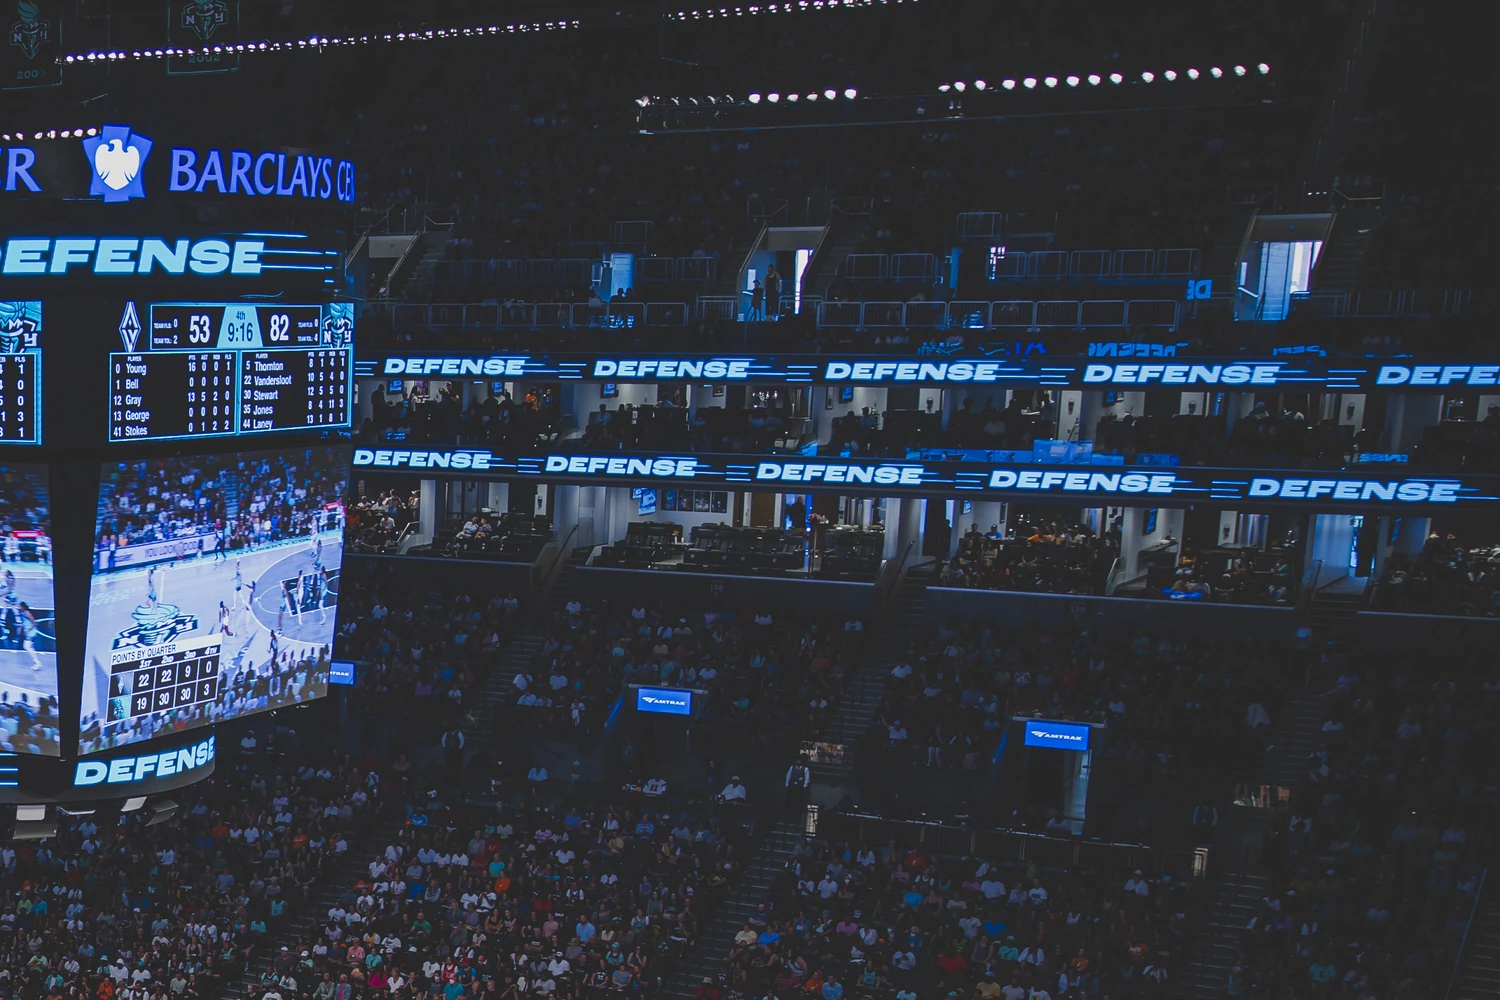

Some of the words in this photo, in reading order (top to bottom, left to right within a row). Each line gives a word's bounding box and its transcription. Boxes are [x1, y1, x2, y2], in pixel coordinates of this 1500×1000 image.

[169, 146, 332, 199] BARCLAYS
[189, 315, 210, 343] 53
[236, 311, 245, 320] 4th
[270, 314, 289, 341] 82
[228, 322, 253, 342] 9:16
[126, 363, 146, 375] Young
[254, 361, 283, 371] Thornton
[384, 358, 525, 375] DEFENSE
[593, 361, 748, 378] DEFENSE
[825, 362, 998, 381] DEFENSE
[1084, 365, 1279, 384] DEFENSE
[125, 379, 138, 389] Bell
[254, 375, 291, 386] Vandersloot
[125, 395, 141, 407] Gray
[254, 390, 278, 400] Stewart
[125, 410, 149, 422] George
[253, 405, 273, 415] Jones
[125, 426, 147, 436] Stokes
[253, 420, 273, 430] Laney
[353, 449, 492, 469] DEFENSE
[546, 456, 698, 477] DEFENSE
[757, 462, 923, 485] DEFENSE
[989, 470, 1176, 493] DEFENSE
[1249, 478, 1461, 503] DEFENSE
[1045, 733, 1083, 741] AMTRAK
[74, 735, 216, 787] DEFENSE
